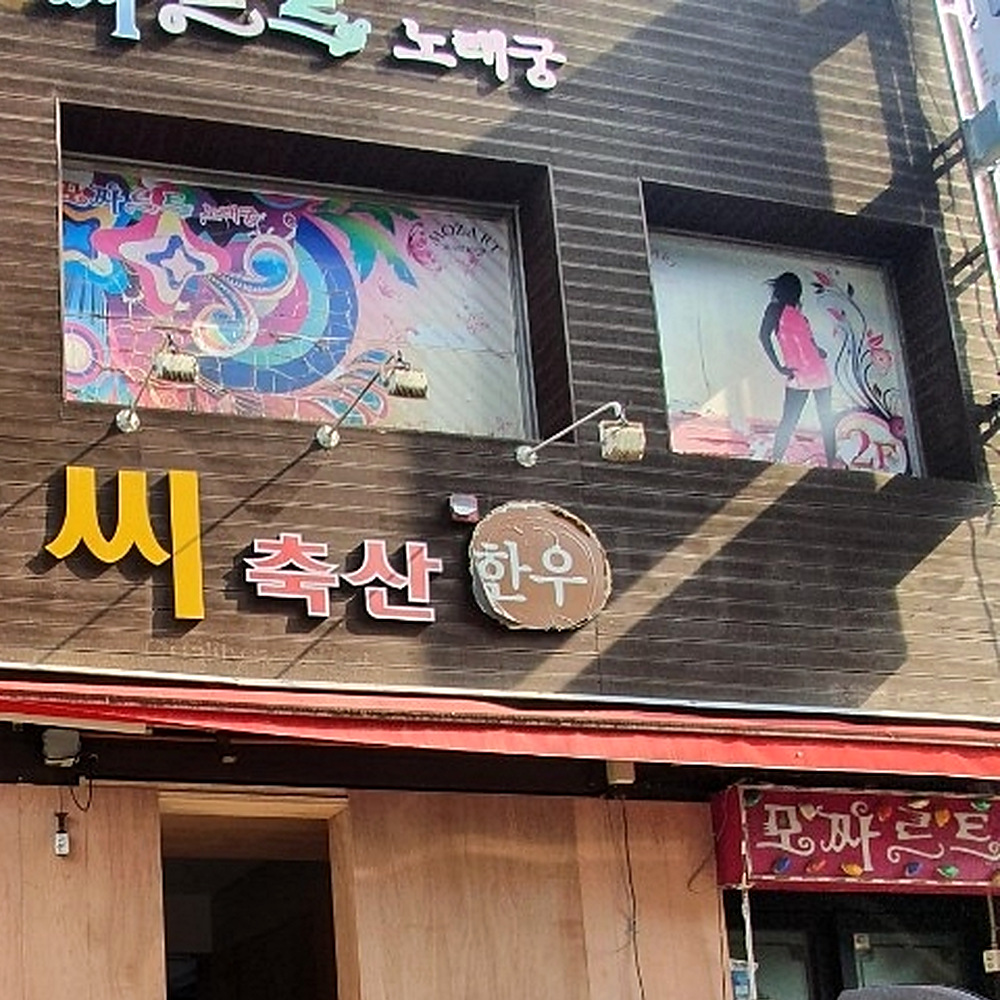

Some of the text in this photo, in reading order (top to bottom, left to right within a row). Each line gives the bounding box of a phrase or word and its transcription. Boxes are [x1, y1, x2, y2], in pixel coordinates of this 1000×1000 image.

[393, 18, 568, 90] 노래궁
[841, 427, 897, 471] 2F
[245, 532, 444, 622] 축산
[472, 540, 589, 608] 한우
[756, 801, 1000, 872] 모짜르트
